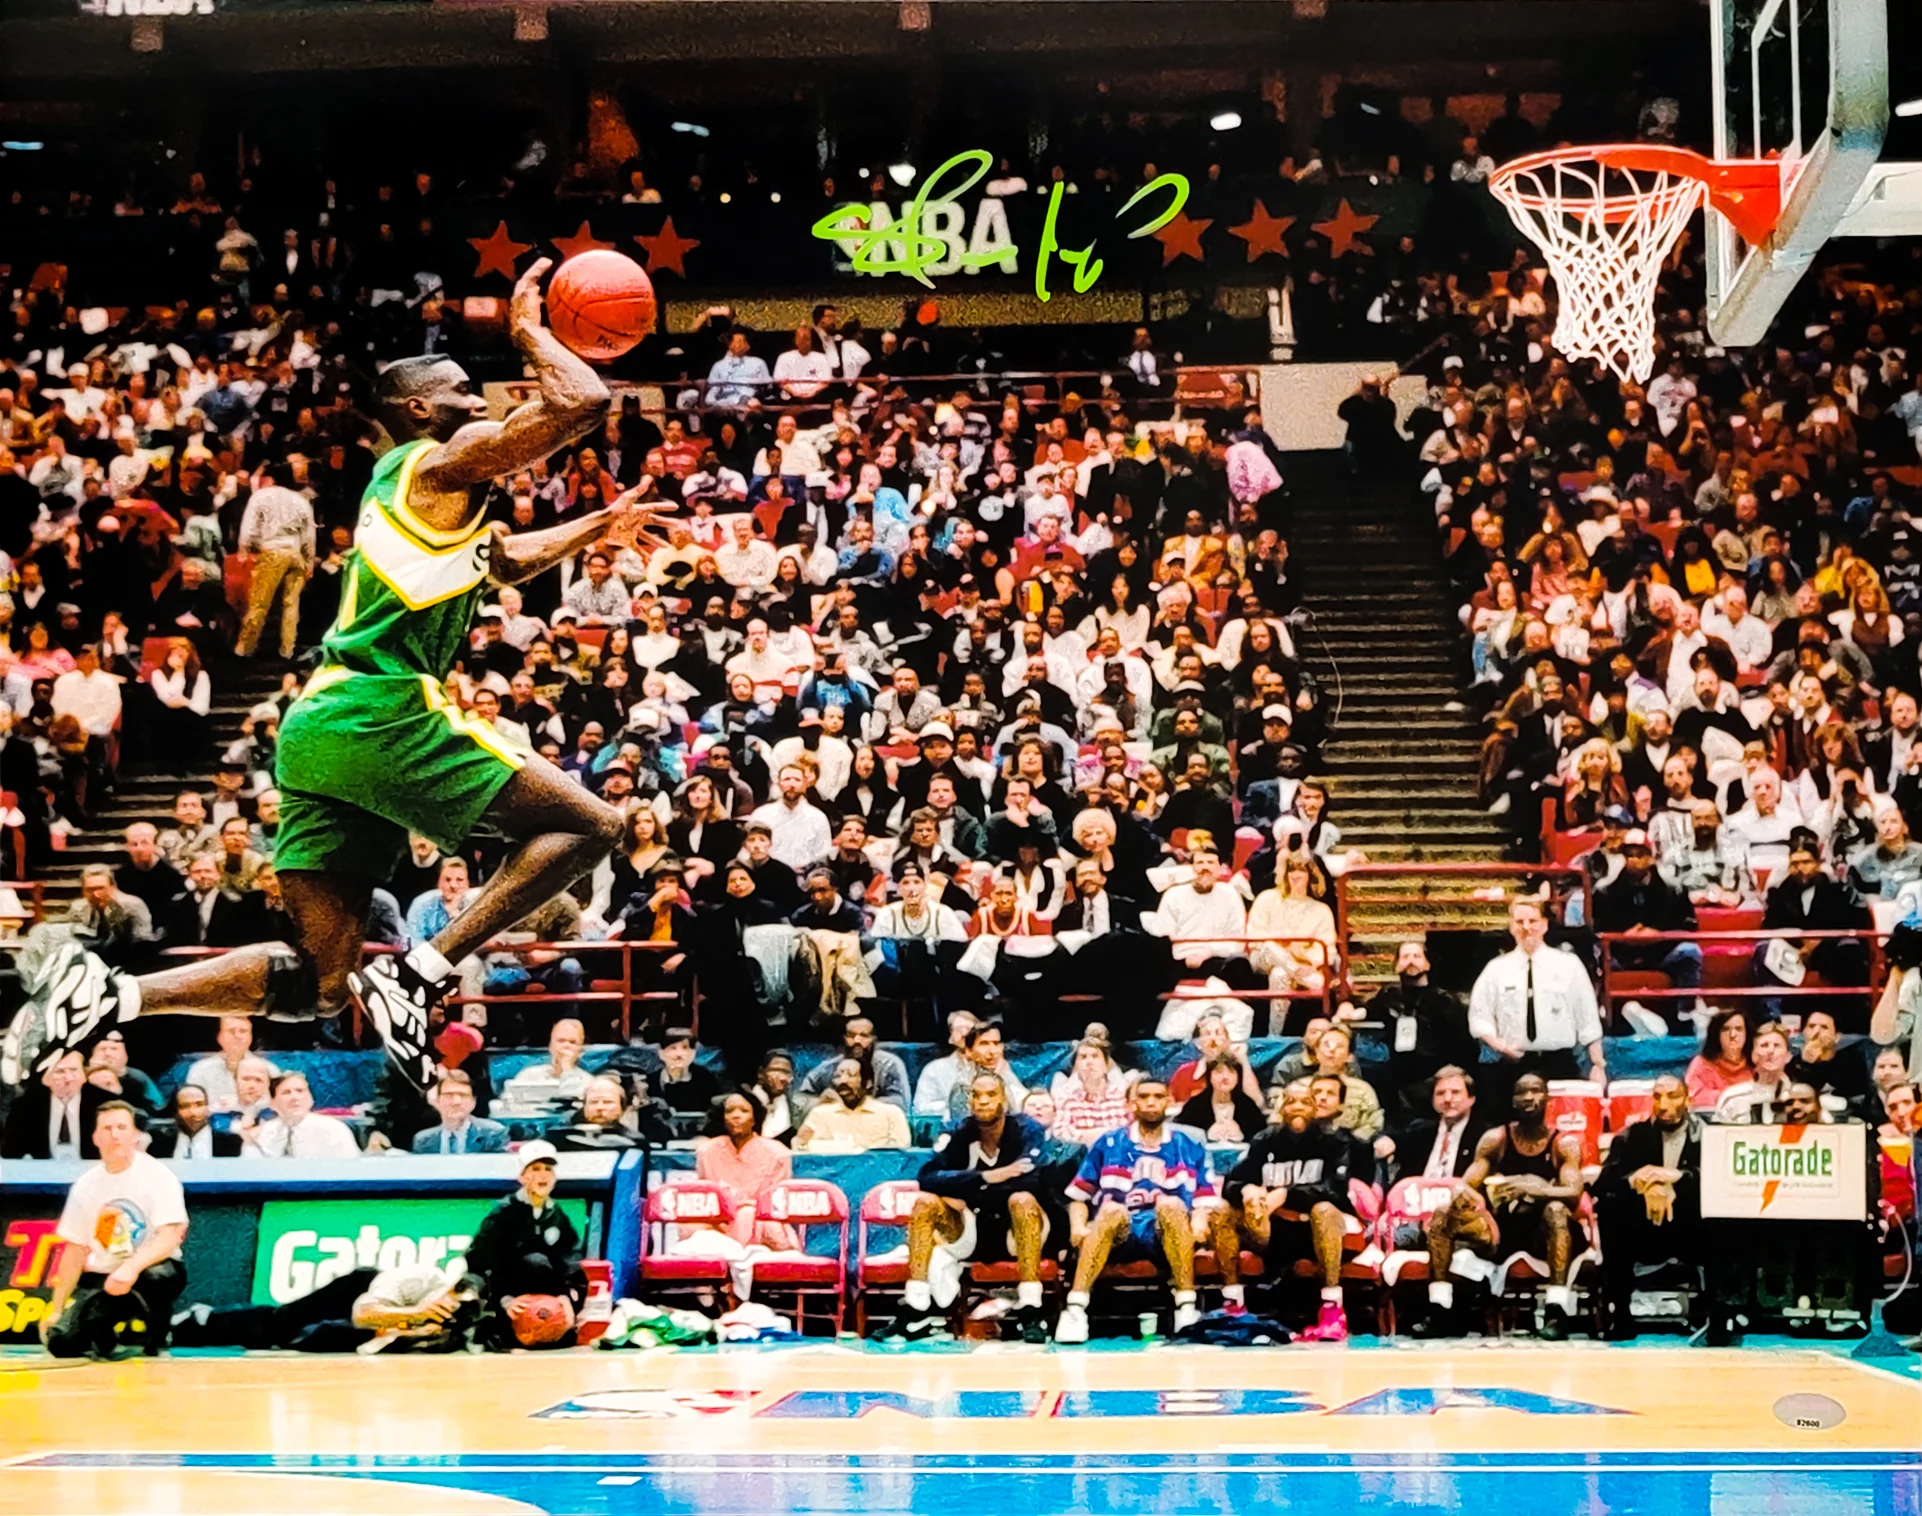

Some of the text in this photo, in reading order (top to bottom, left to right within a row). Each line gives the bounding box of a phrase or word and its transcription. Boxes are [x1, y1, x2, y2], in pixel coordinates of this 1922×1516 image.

[866, 199, 1018, 277] NBA
[1733, 1140, 1833, 1176] Gatorade
[677, 1191, 721, 1218] NBA
[788, 1190, 832, 1217] NBA
[269, 1224, 474, 1305] Gator
[753, 1387, 1641, 1418] NBA
